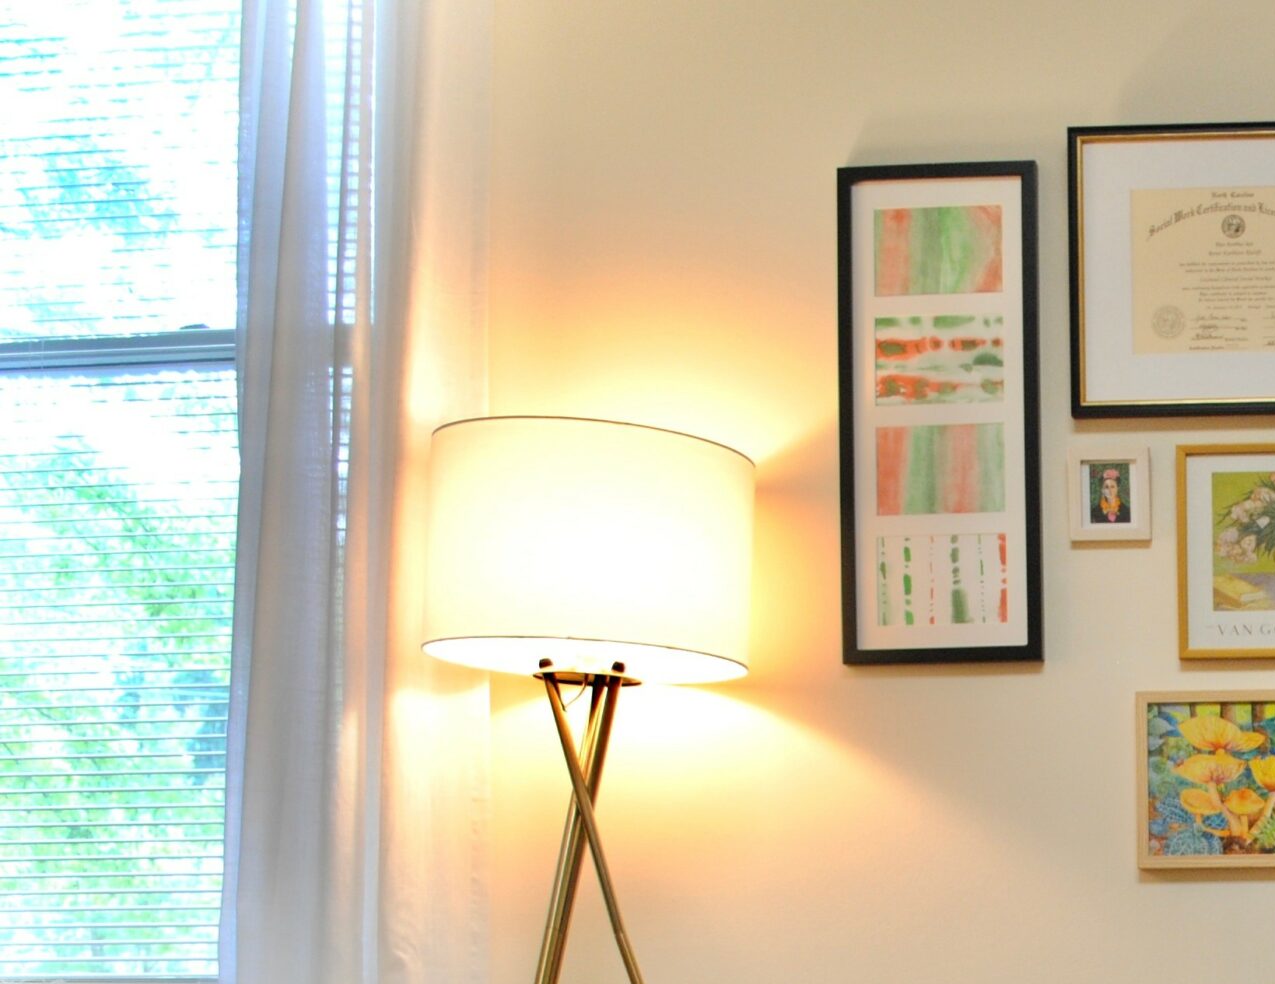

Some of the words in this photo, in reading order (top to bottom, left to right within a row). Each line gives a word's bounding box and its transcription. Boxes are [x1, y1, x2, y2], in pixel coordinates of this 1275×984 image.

[1174, 209, 1196, 224] Work
[1196, 202, 1243, 215] Certification
[1217, 624, 1253, 636] VAN
